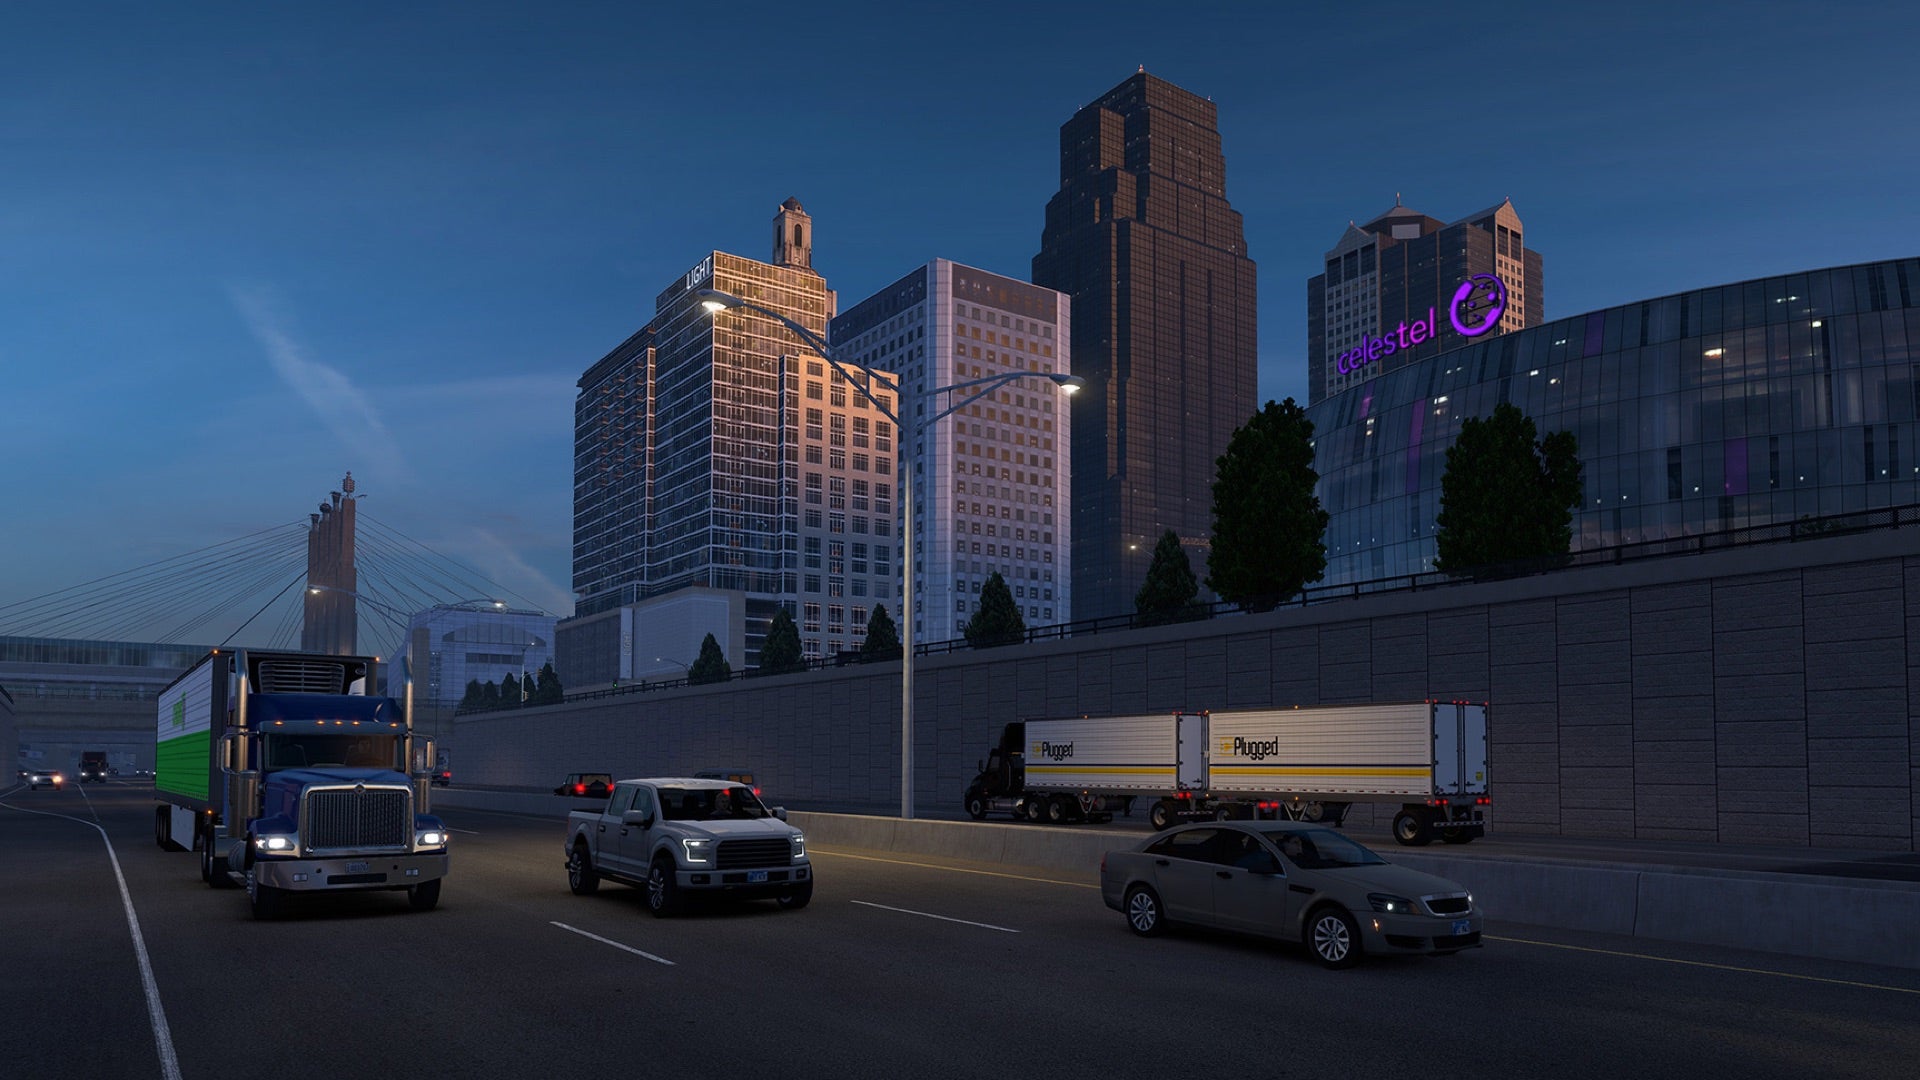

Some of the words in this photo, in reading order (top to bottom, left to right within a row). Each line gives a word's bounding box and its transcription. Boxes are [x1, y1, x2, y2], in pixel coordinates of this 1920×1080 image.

[686, 256, 712, 290] LIGHT
[1337, 305, 1436, 375] celestel
[1041, 741, 1073, 761] Plugged
[1234, 736, 1278, 761] Plugged
